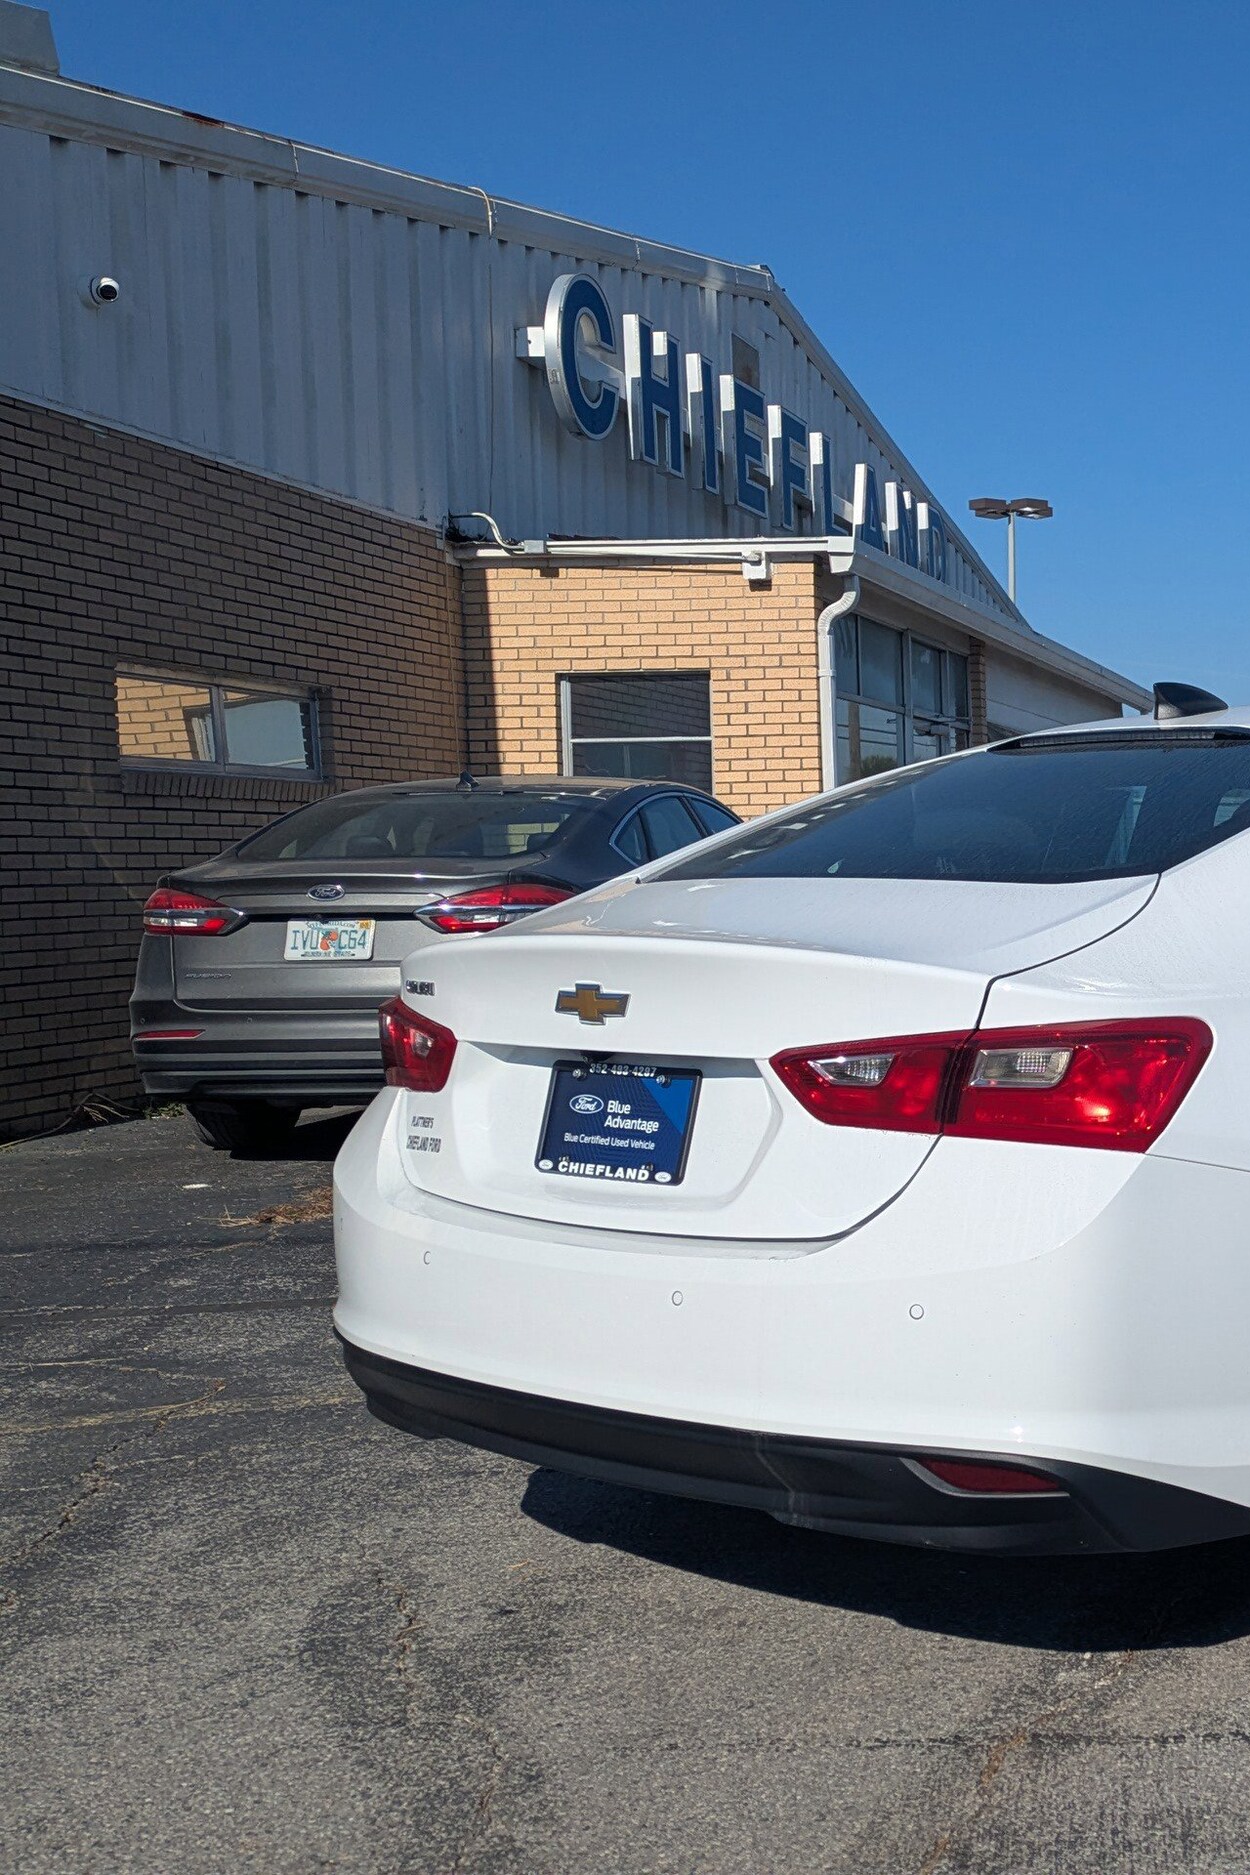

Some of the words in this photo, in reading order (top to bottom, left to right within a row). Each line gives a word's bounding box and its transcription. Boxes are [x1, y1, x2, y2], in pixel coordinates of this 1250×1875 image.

[544, 273, 946, 583] CHIEFLAND
[338, 929, 367, 950] C64
[575, 1097, 598, 1111] Ford
[607, 1100, 631, 1114] Blue
[604, 1115, 659, 1134] Advantage
[564, 1132, 579, 1142] Blue
[580, 1133, 610, 1145] Certified
[611, 1138, 629, 1148] Used
[630, 1139, 655, 1150] Vehicle
[558, 1160, 650, 1181] CHIEFLAND
